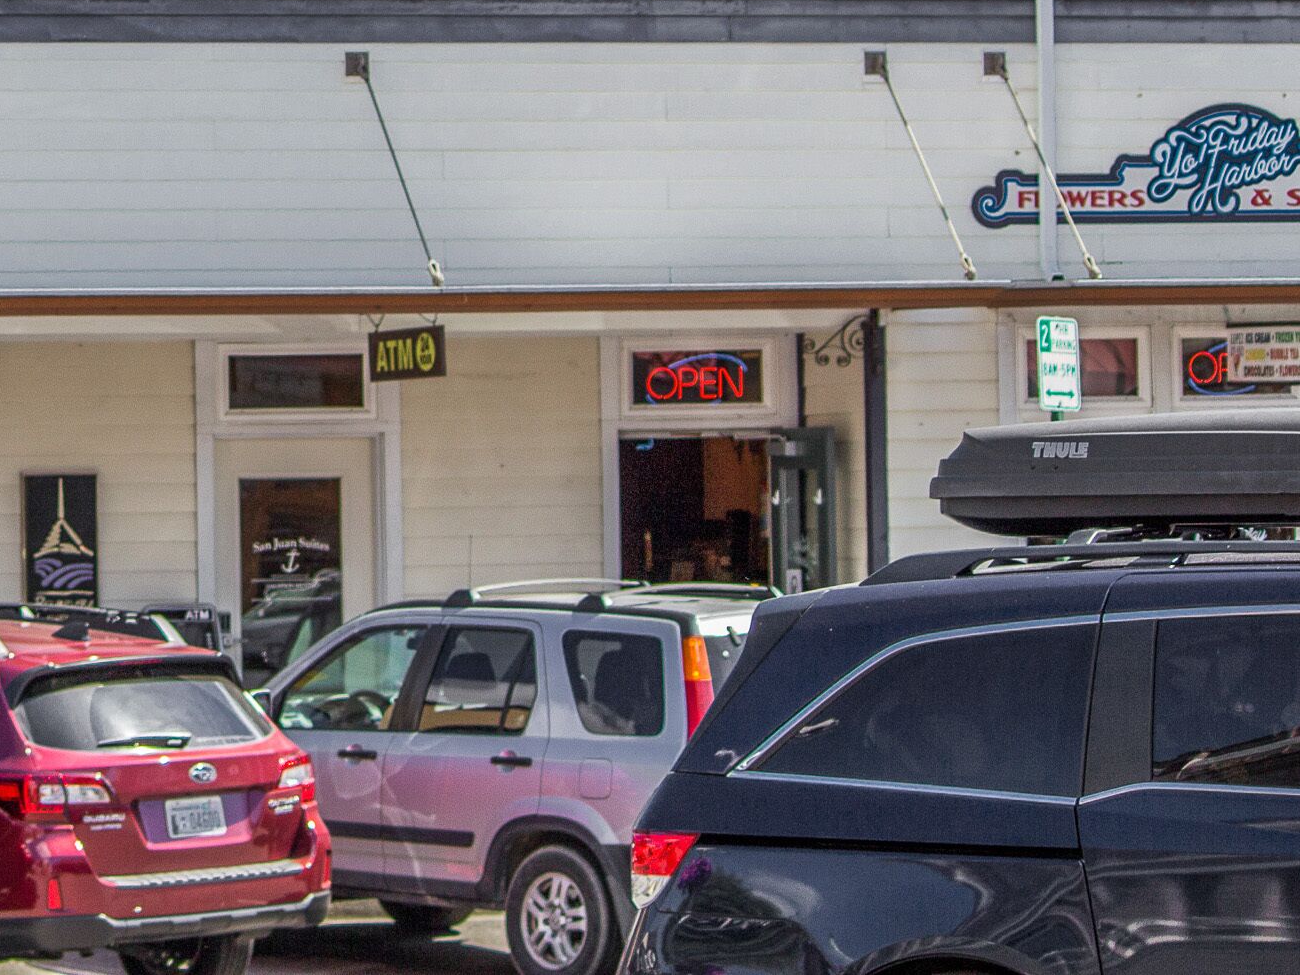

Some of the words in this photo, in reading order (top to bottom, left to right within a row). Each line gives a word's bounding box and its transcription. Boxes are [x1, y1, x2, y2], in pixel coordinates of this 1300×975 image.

[1208, 115, 1297, 170] Friday
[1192, 151, 1300, 213] Harbor
[1250, 188, 1273, 207] &
[1041, 324, 1049, 347] 2
[1052, 338, 1077, 350] PARKING
[1254, 331, 1271, 344] CREAM
[376, 336, 414, 373] ATM
[645, 365, 744, 400] OPEN
[1031, 441, 1090, 459] THULE
[252, 540, 272, 554] San
[272, 536, 297, 552] Juan
[298, 536, 331, 552] Suites
[184, 609, 211, 621] ATM
